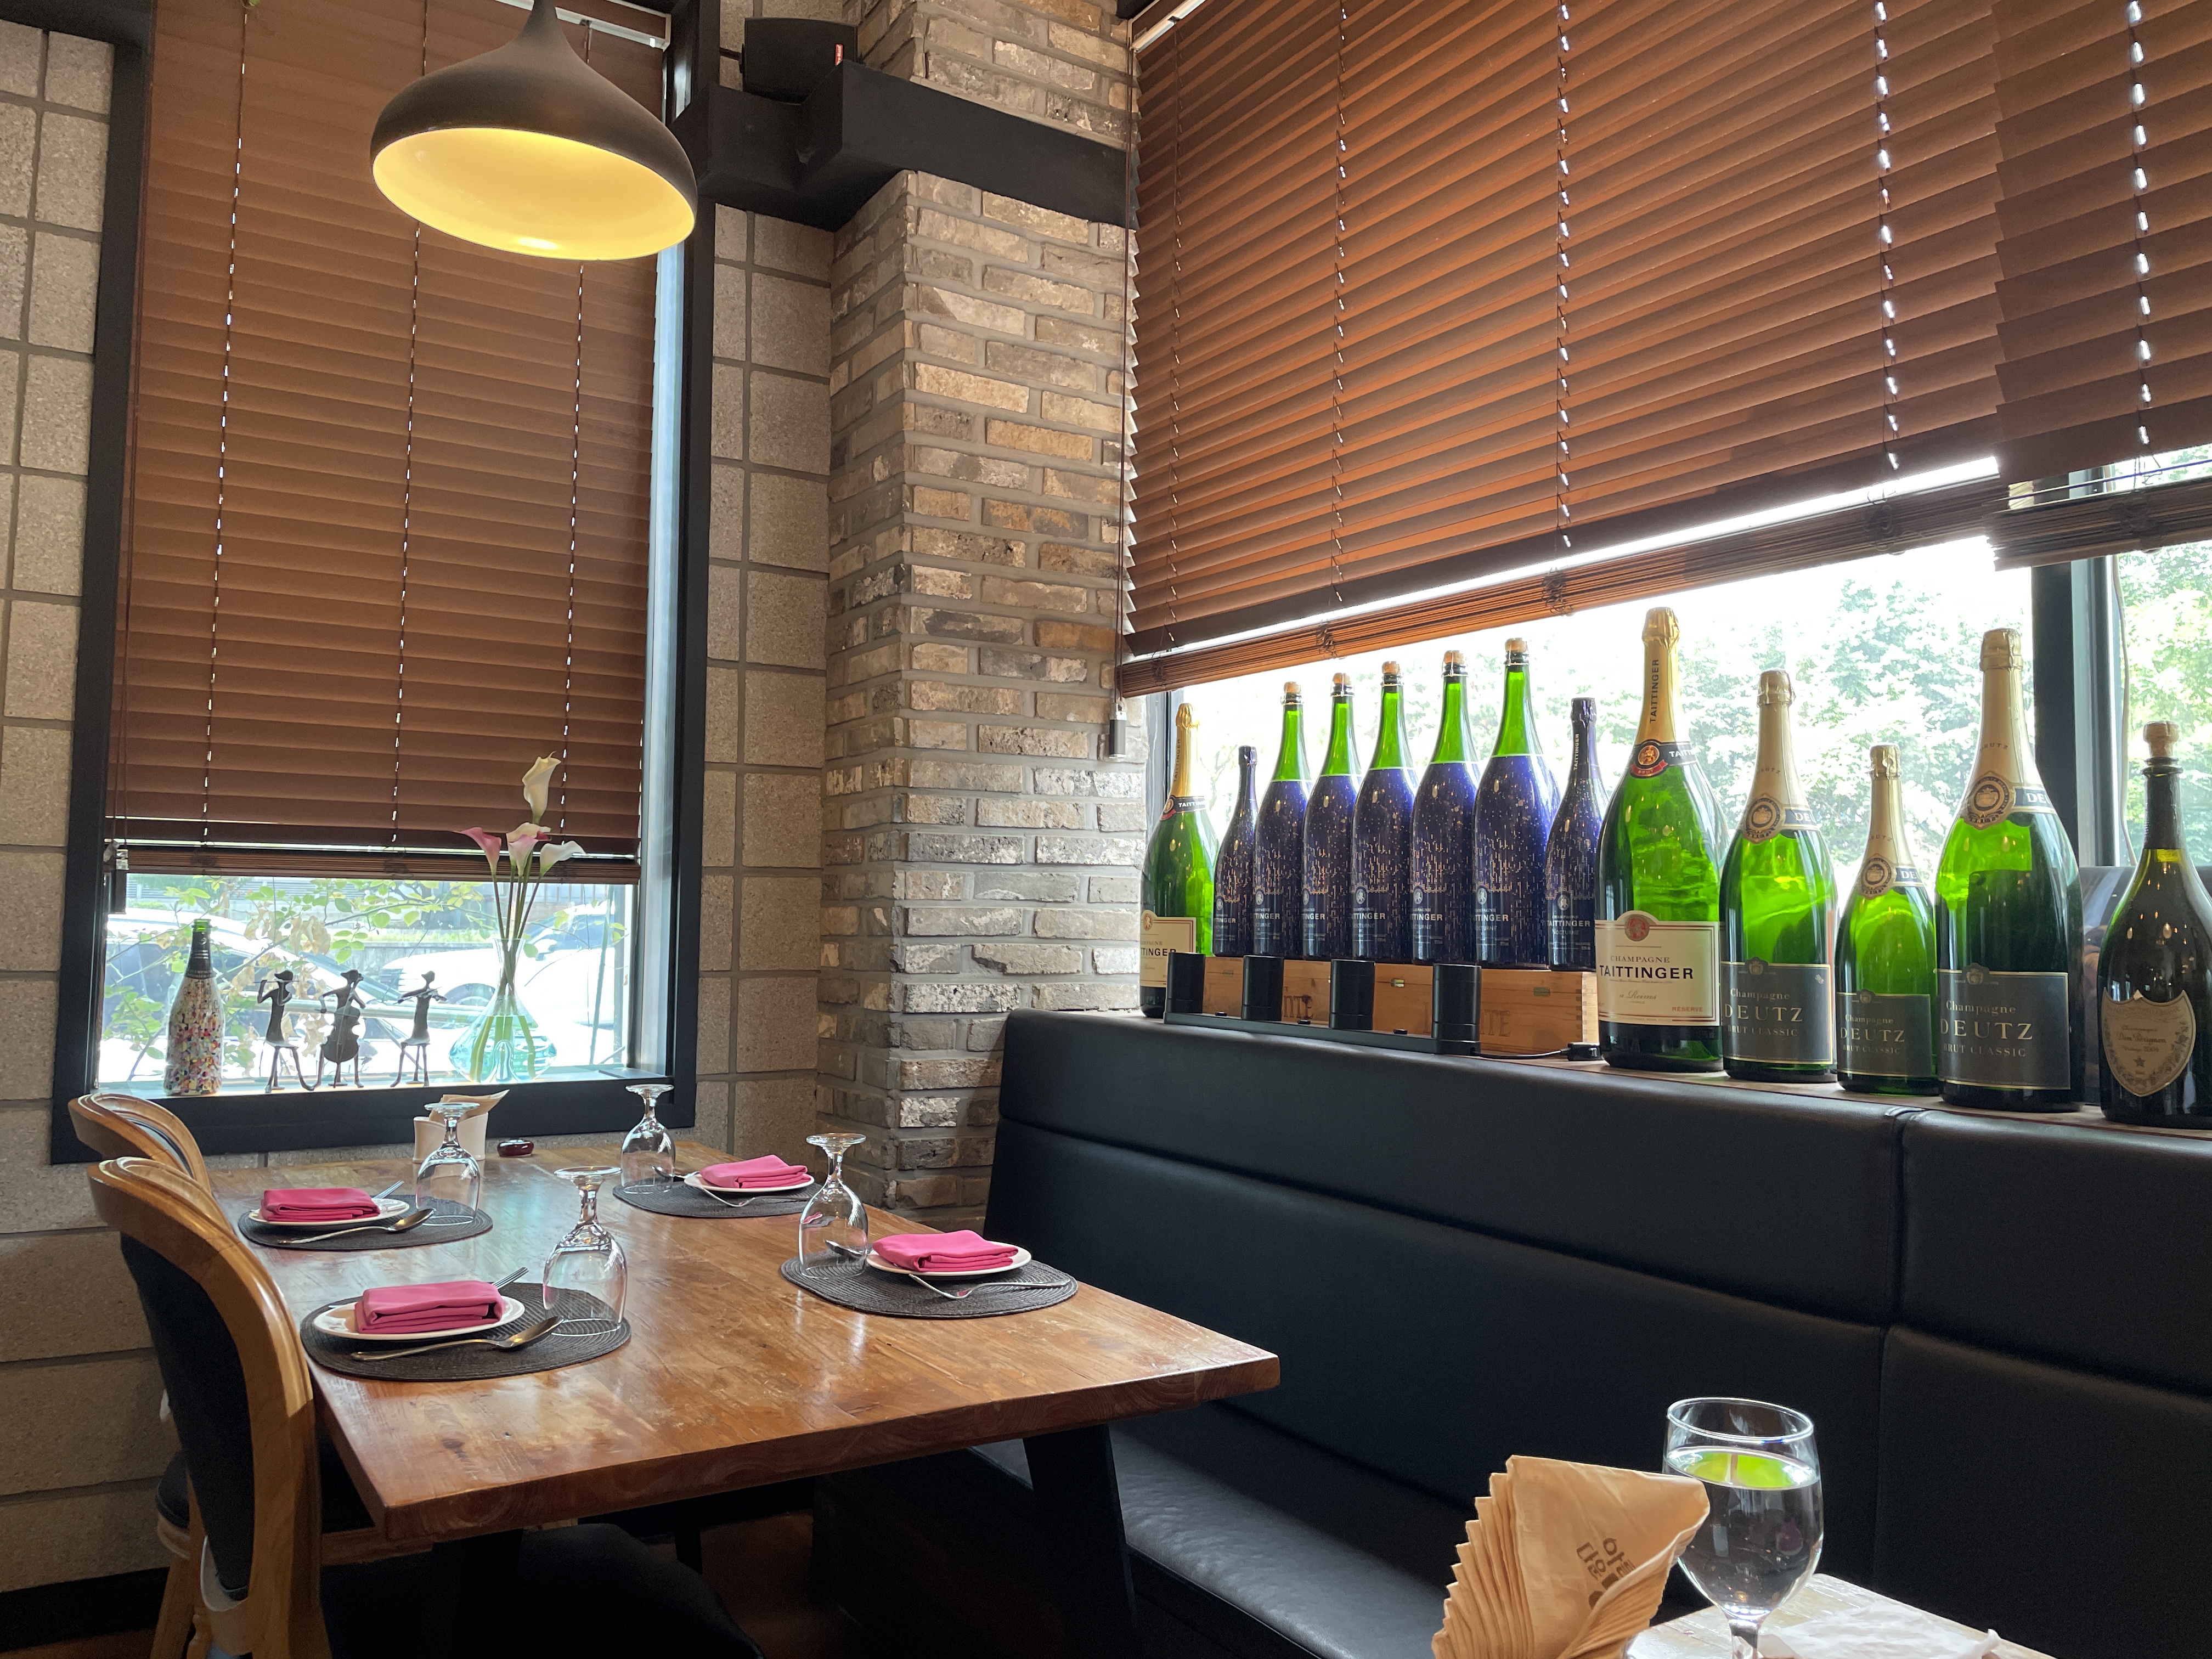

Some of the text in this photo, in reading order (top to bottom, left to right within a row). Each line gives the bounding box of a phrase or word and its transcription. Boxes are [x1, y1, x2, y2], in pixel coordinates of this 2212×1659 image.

[1649, 659, 1659, 724] TAITTINGER
[1610, 955, 1670, 963] CHAMPAGNE
[1600, 965, 1694, 979] TAITTINGER
[1626, 990, 1657, 1000] Reims
[1730, 988, 1790, 1002] Champagne
[1725, 1003, 1803, 1022] DEUTZ
[1946, 1000, 2016, 1017] Champagne
[1845, 1014, 1894, 1025] Champagne
[1728, 1025, 1798, 1036] BRUT CLASSIC
[1841, 1027, 1905, 1042] DEUTZ
[1940, 1018, 2033, 1040] DEUTZ
[1863, 1046, 1900, 1054] CLASSIC
[1943, 1043, 2026, 1057] BRUT CLASSIC
